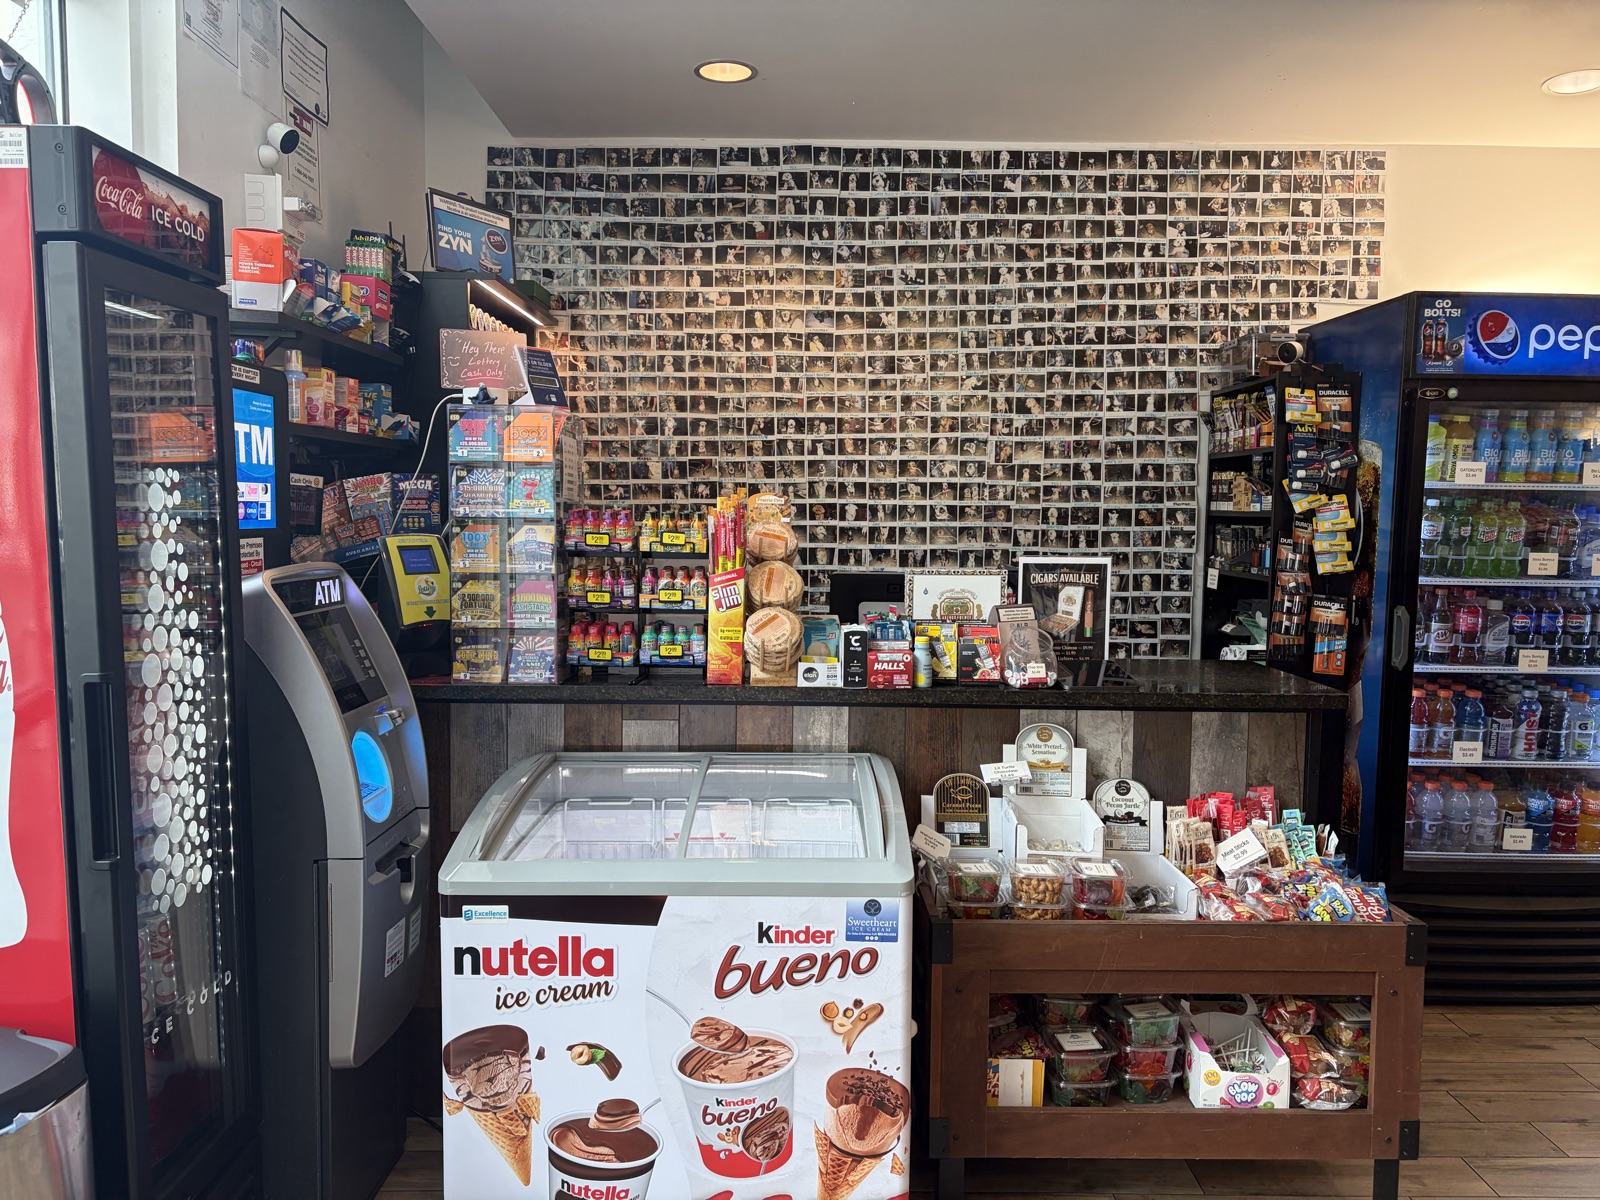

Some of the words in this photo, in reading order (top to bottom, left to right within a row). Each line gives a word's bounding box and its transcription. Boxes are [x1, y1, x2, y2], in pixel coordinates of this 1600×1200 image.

[151, 205, 172, 229] ICE
[174, 215, 205, 243] COLD
[438, 224, 452, 233] FIND
[454, 228, 472, 238] YOUR
[438, 232, 472, 256] ZYN
[1424, 309, 1461, 317] BOLTS!
[1528, 324, 1600, 360] pep
[468, 356, 500, 368] Lottery
[460, 368, 482, 378] Cash
[487, 364, 507, 377] Only!
[461, 419, 487, 430] 500X
[1295, 424, 1316, 432] Advi
[512, 427, 546, 438] 500X
[234, 422, 273, 466] TM
[1515, 449, 1528, 457] BIO
[399, 480, 432, 490] MEGA
[521, 480, 539, 500] 7
[462, 533, 488, 542] 100X
[345, 546, 374, 556] AVAILABLE
[714, 572, 738, 583] ORIGINAL
[1031, 573, 1058, 584] CIGARS
[1059, 573, 1099, 585] AVAILABLE
[315, 578, 340, 605] ATM
[528, 603, 552, 612] STACKS
[1425, 824, 1436, 833] G
[1221, 848, 1236, 859] Meat
[1235, 840, 1250, 851] Sticks
[1233, 849, 1248, 860] $2.99
[1333, 900, 1349, 915] RAP
[848, 917, 897, 927] Sweetheart
[757, 922, 835, 946] kinder
[454, 936, 614, 977] nutella
[714, 944, 879, 1000] bueno
[187, 970, 231, 1015] COLD
[495, 986, 531, 1011] ice
[536, 980, 614, 1006] cream
[1204, 1071, 1218, 1080] 100
[1228, 1081, 1259, 1095] BLOW
[716, 1097, 757, 1107] kinder
[1235, 1092, 1256, 1103] POP
[702, 1097, 778, 1126] bueno
[561, 1179, 630, 1200] nutella
